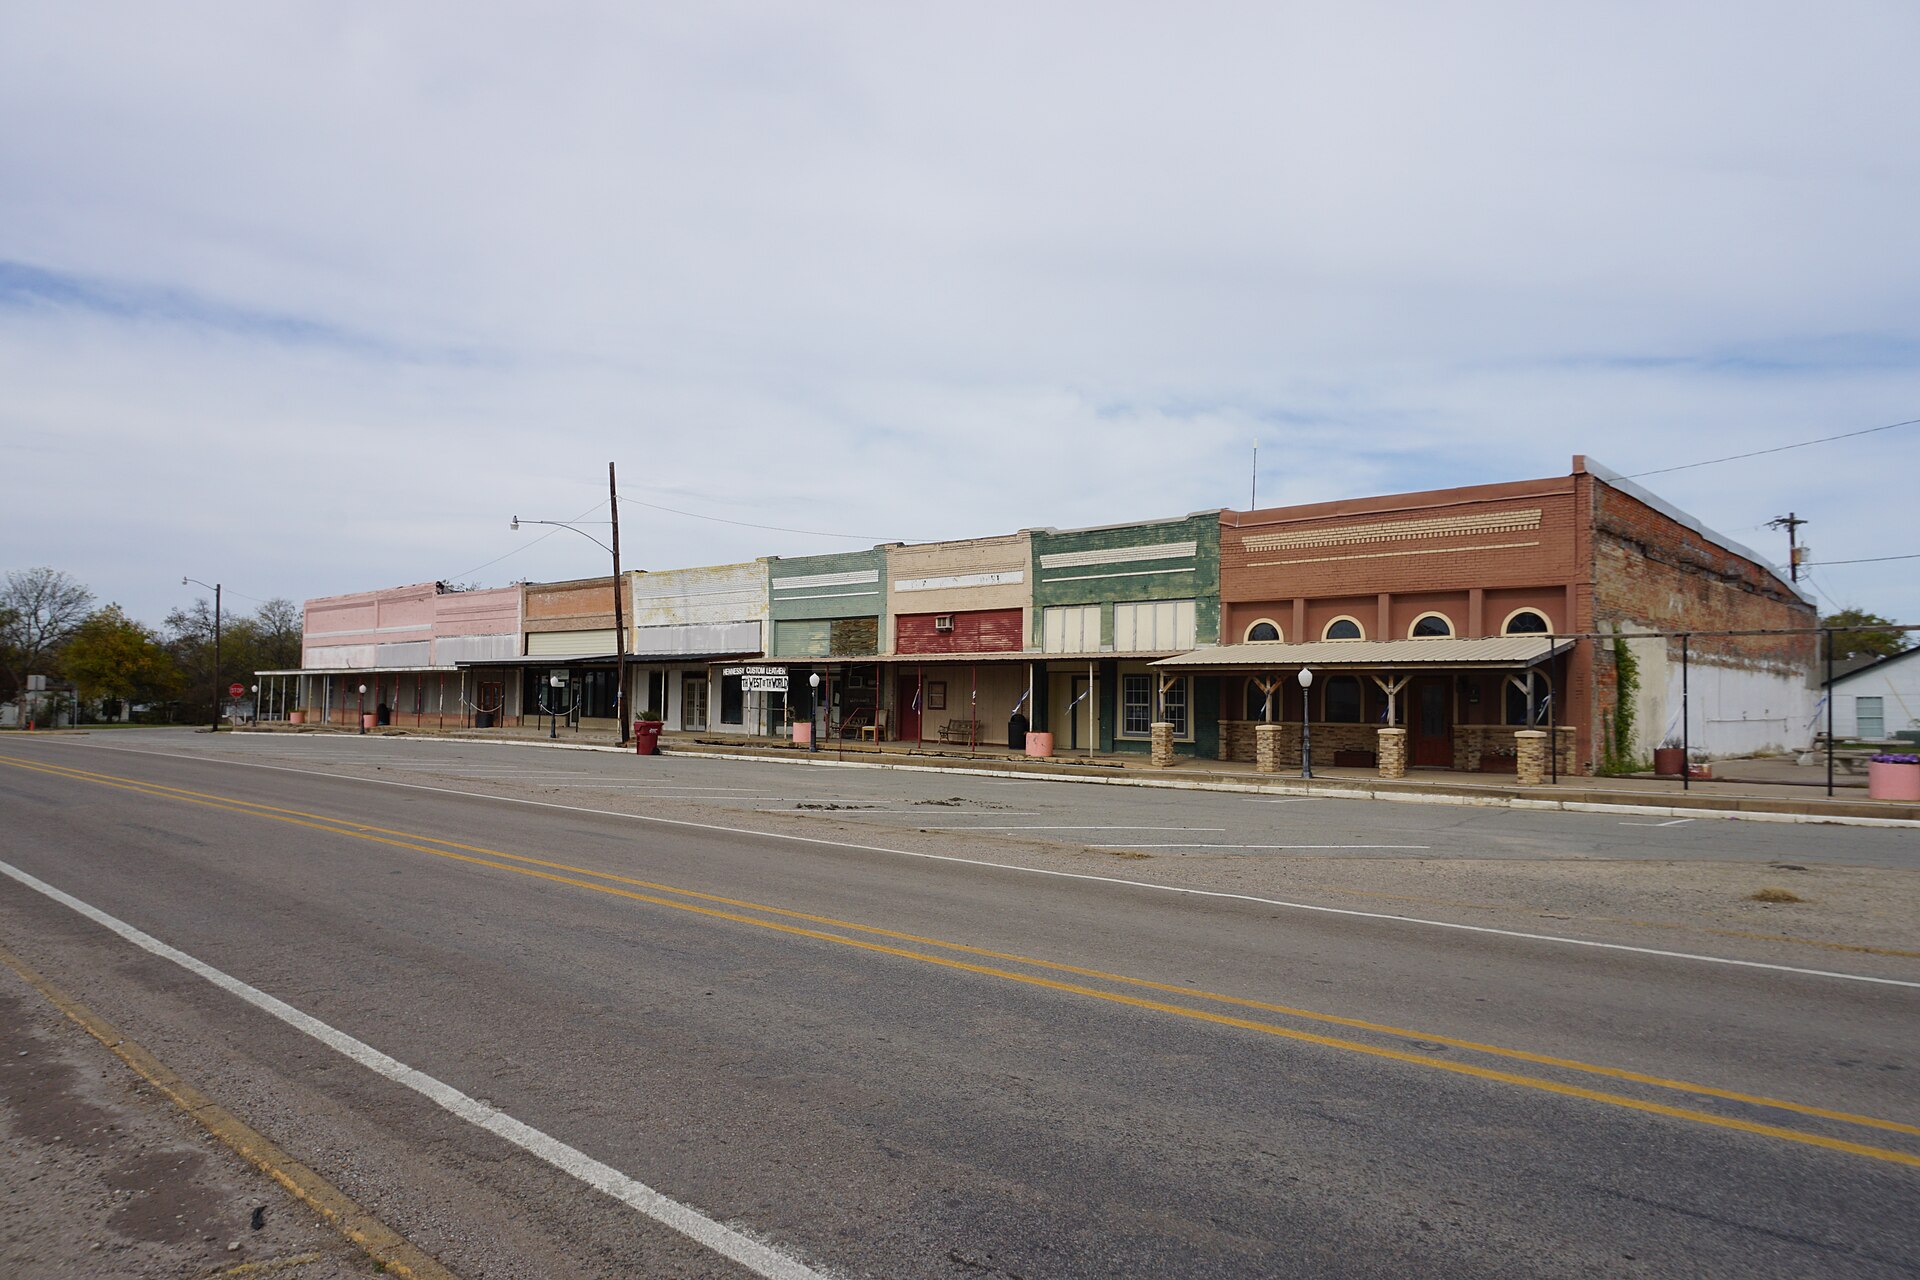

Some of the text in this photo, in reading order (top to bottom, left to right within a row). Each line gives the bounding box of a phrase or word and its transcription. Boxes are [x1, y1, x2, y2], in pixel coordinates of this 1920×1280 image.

[746, 666, 766, 674] CUSTOM
[766, 666, 786, 675] LEATHER
[749, 678, 762, 688] WEST
[772, 678, 789, 689] WORLD
